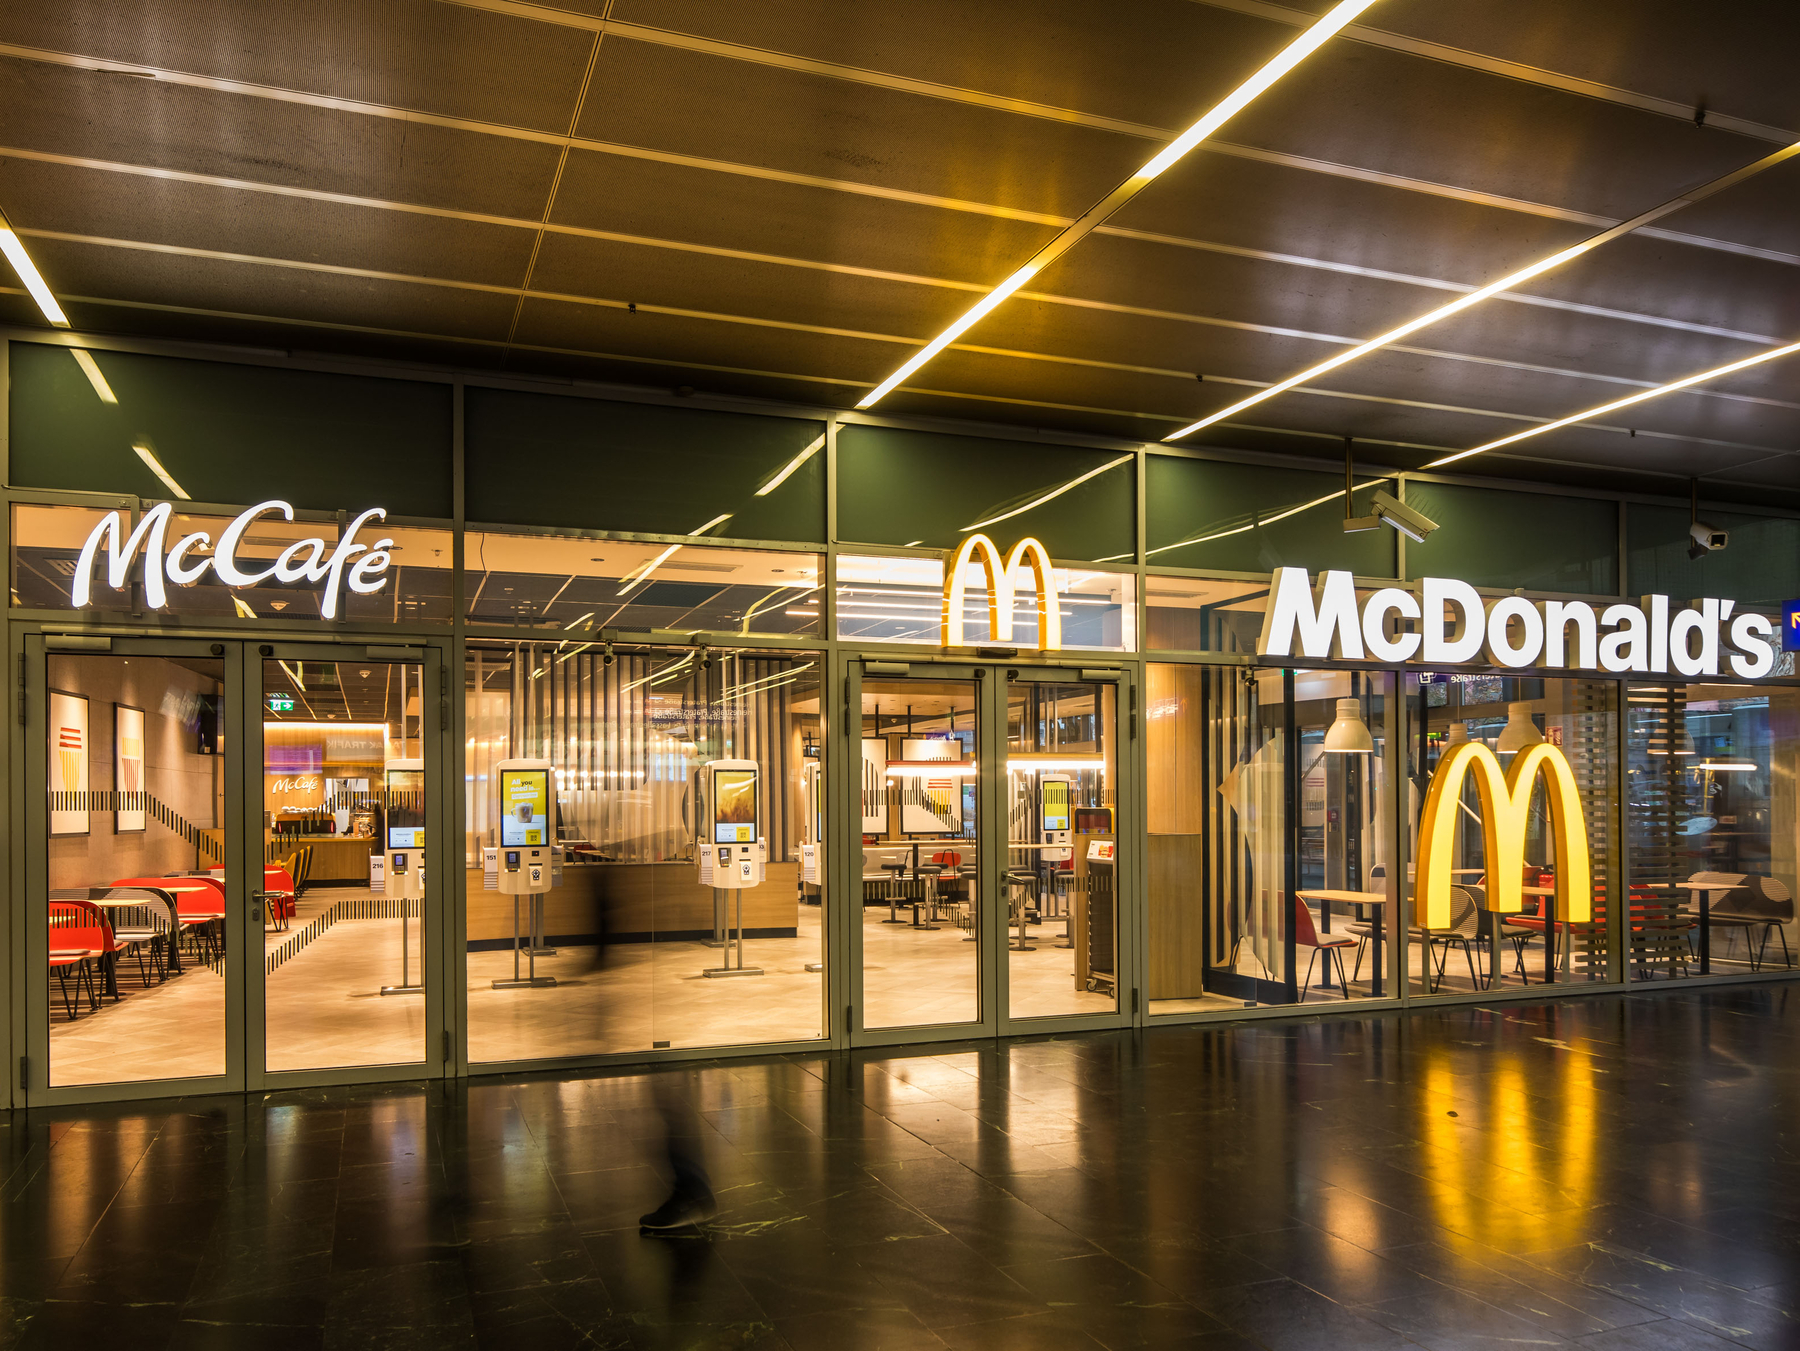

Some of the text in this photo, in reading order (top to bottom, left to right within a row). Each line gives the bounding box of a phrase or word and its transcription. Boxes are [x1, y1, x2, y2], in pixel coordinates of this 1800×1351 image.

[72, 500, 394, 619] McCafé
[1262, 567, 1774, 679] McDonald's
[272, 777, 319, 794] McCafé
